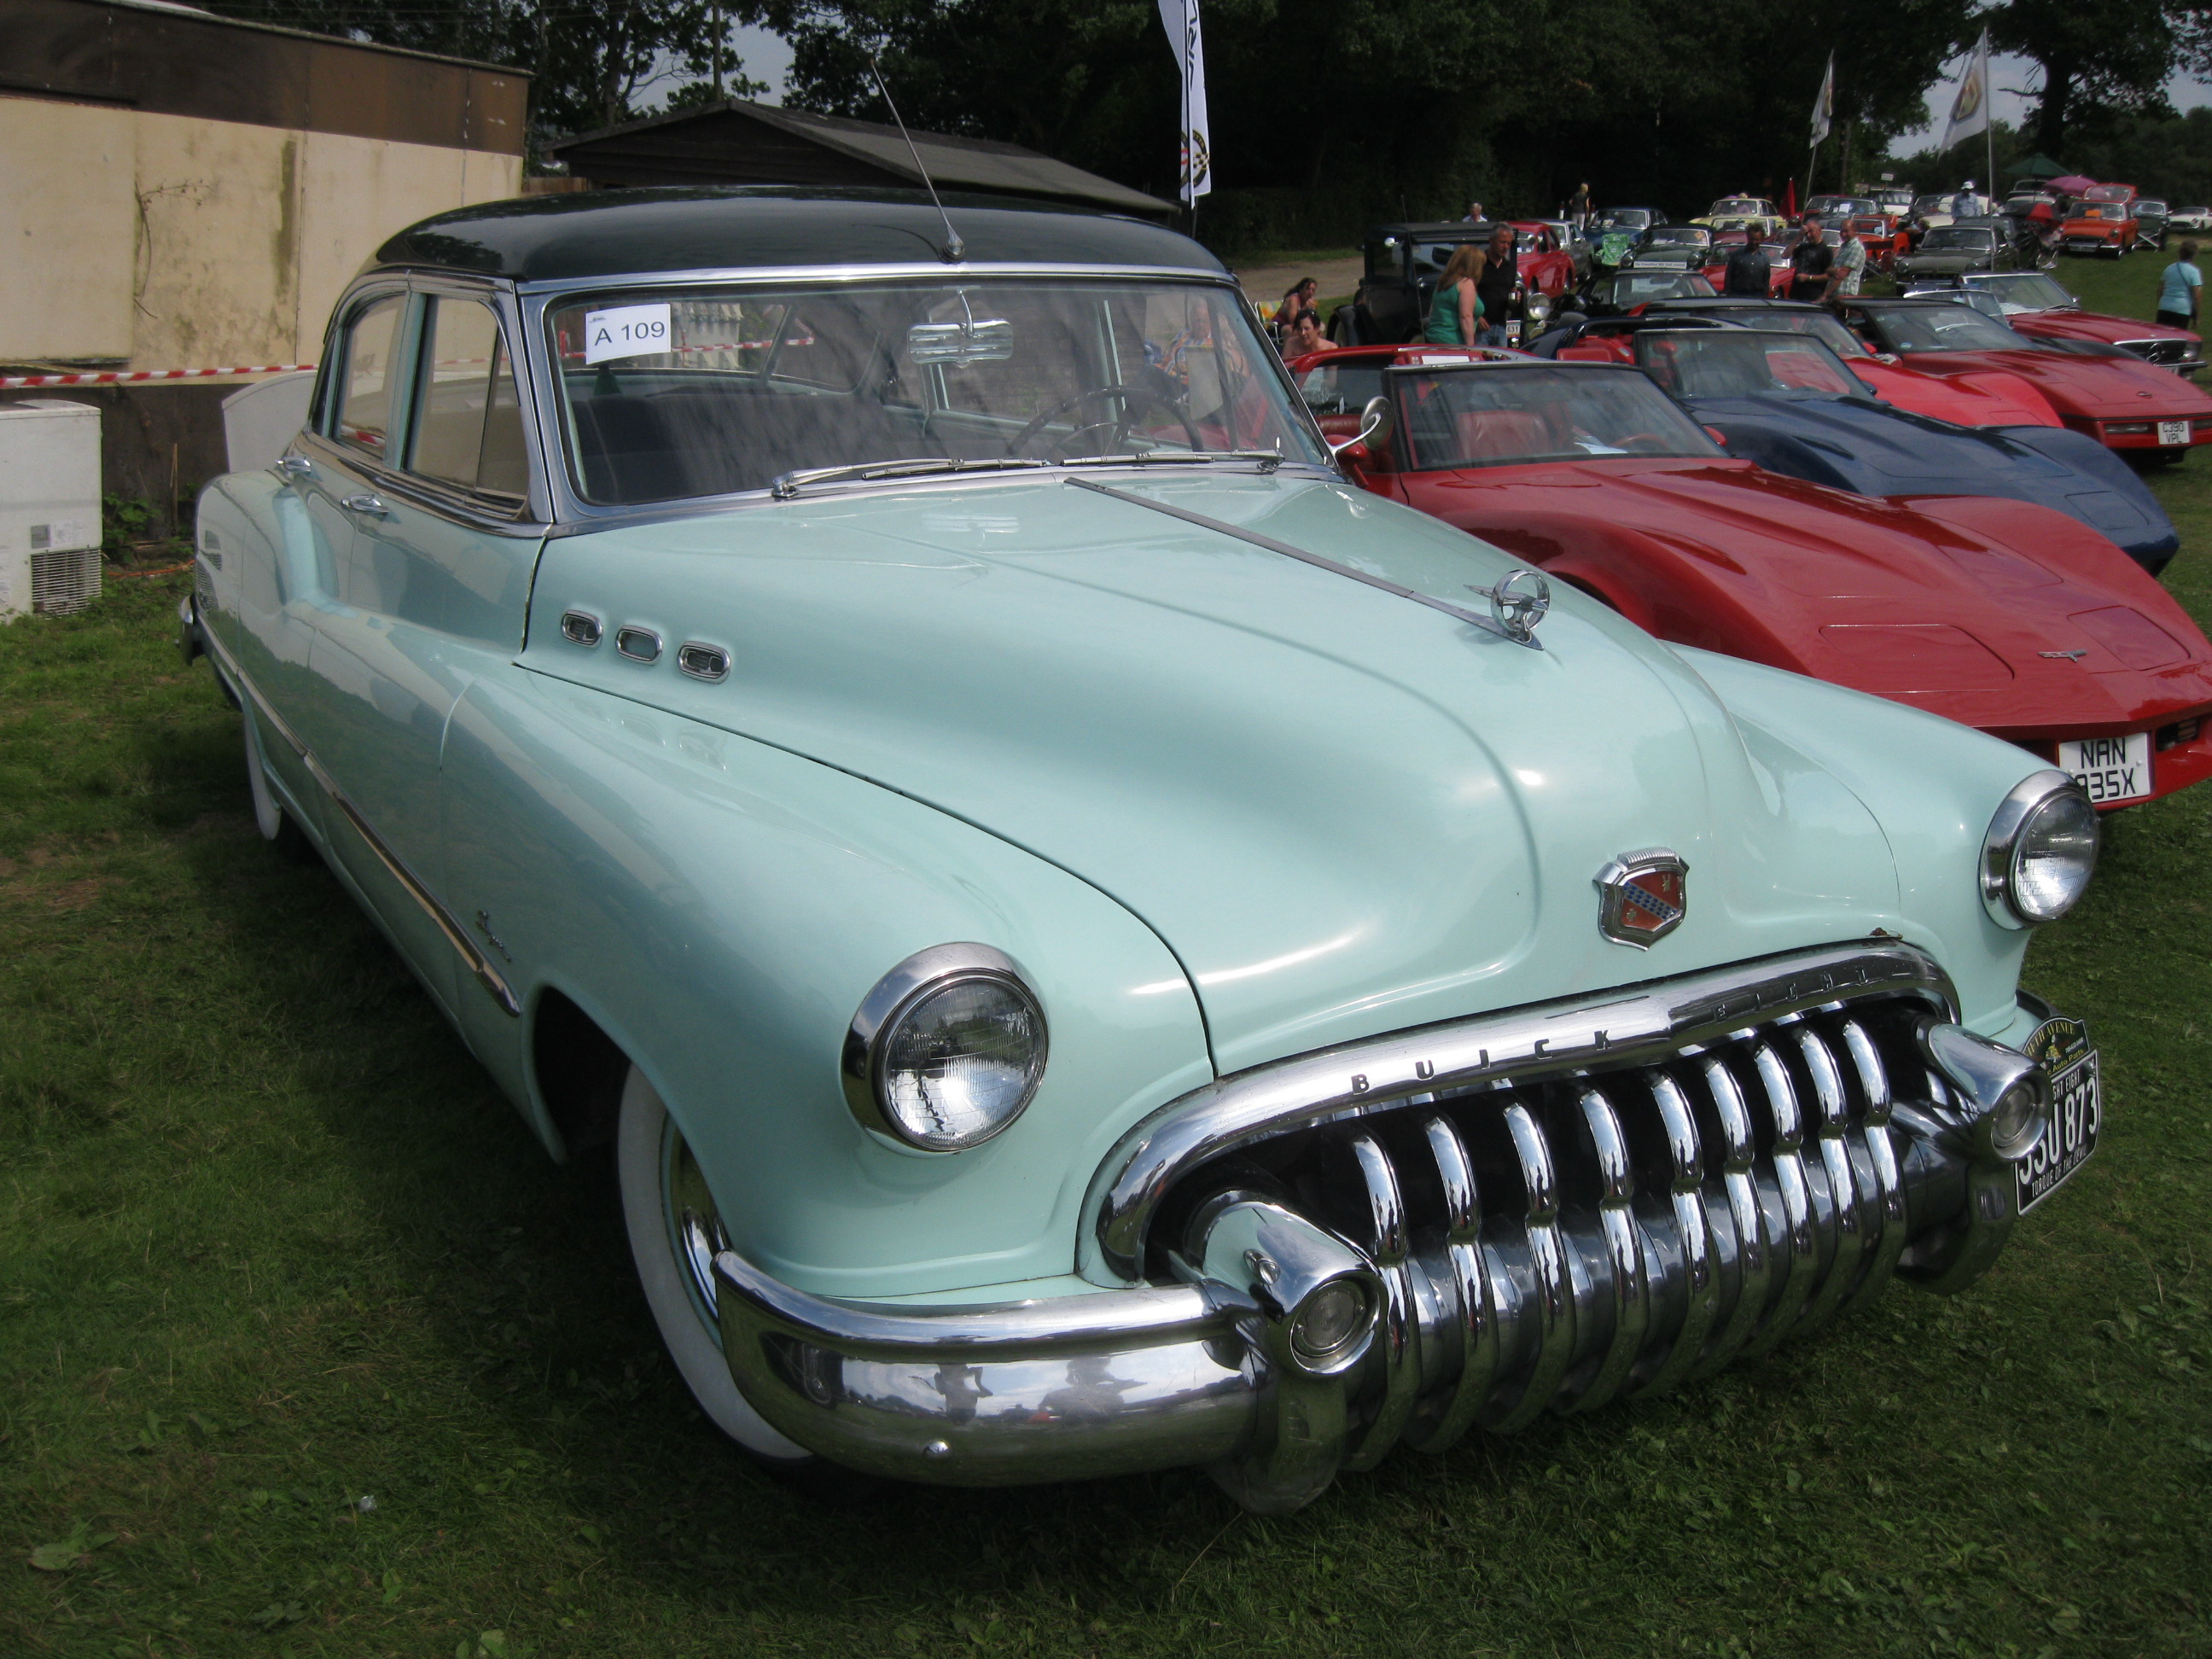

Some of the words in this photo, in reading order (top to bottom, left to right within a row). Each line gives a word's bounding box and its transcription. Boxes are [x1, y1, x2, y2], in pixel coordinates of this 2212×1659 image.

[594, 328, 613, 346] A
[621, 321, 666, 341] 109
[2162, 422, 2185, 433] C390
[2165, 434, 2183, 444] VPL
[2080, 737, 2126, 769] NAN
[2075, 767, 2136, 800] 935X
[2046, 1021, 2075, 1036] AVENUE
[1351, 1029, 1613, 1097] BUICK
[2052, 1059, 2068, 1073] Auto
[2064, 1077, 2098, 1152] 873
[2032, 1168, 2054, 1197] TORQUE
